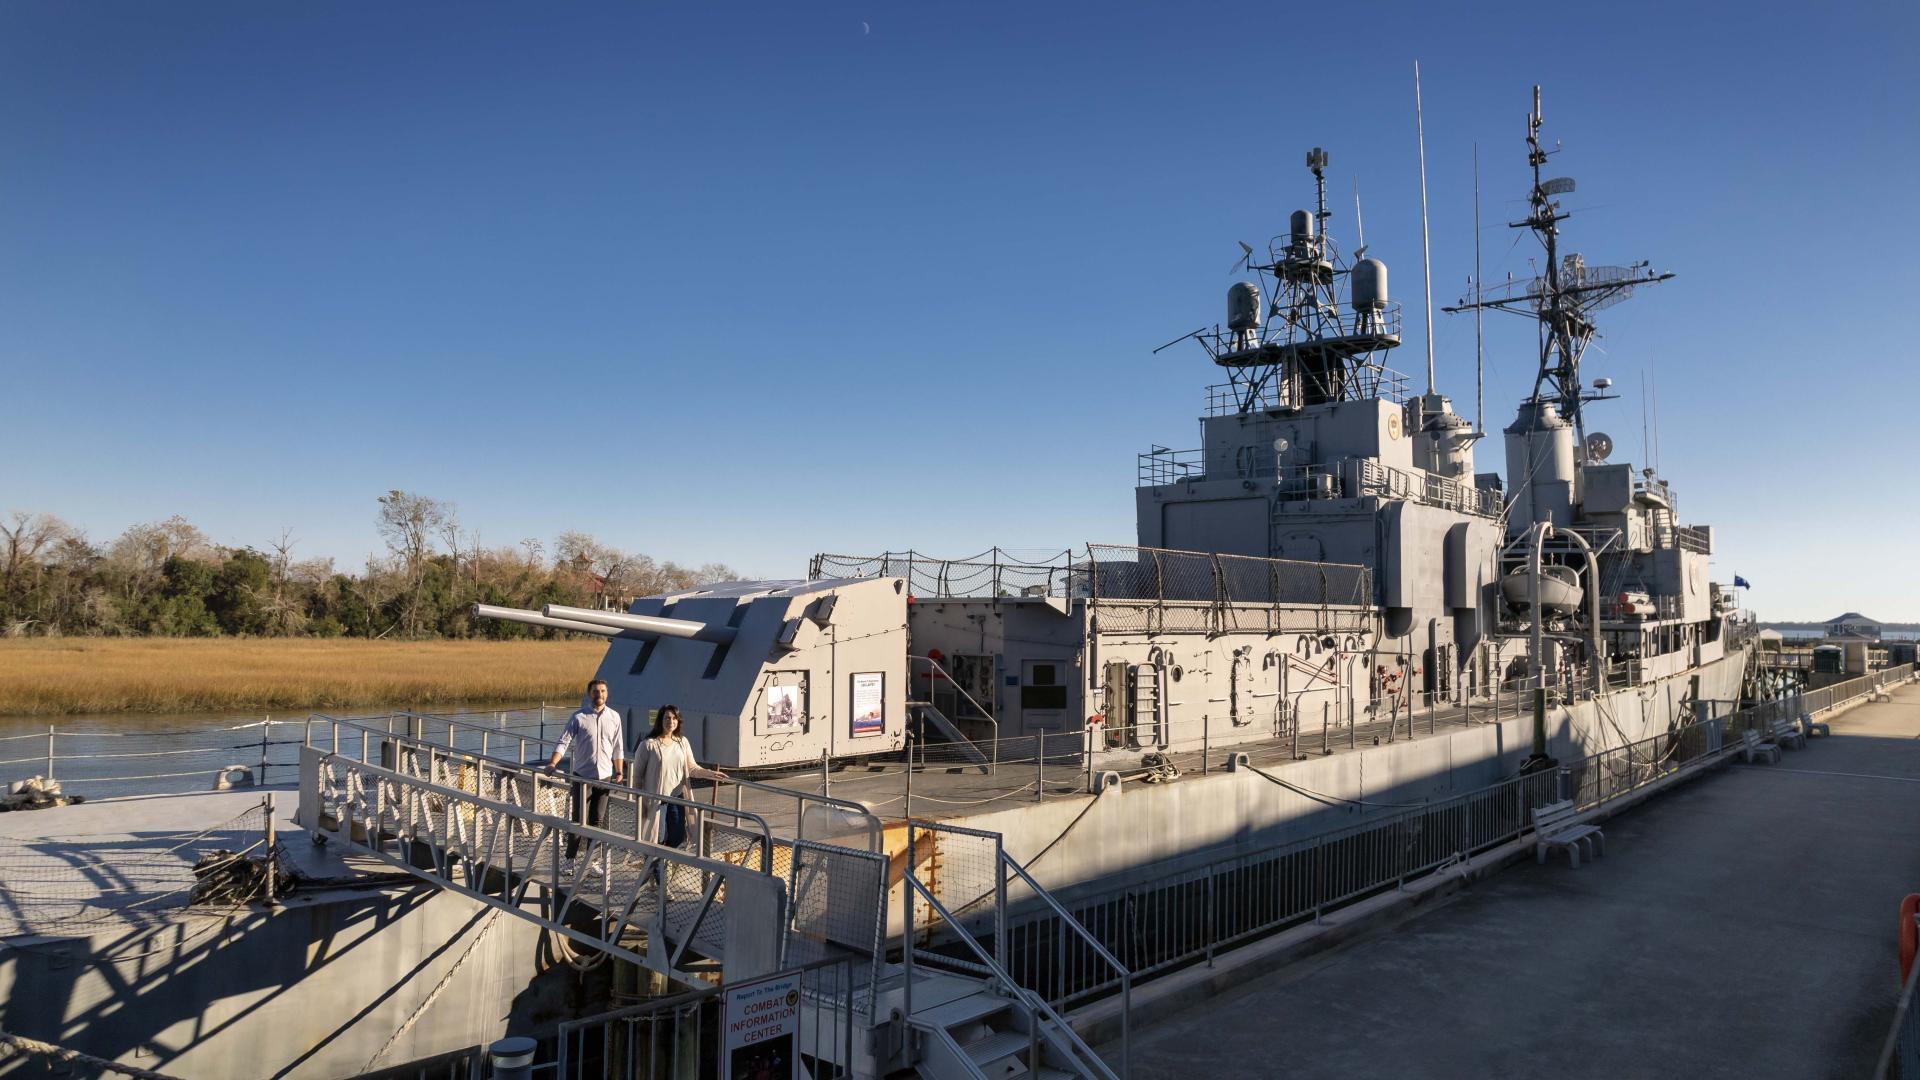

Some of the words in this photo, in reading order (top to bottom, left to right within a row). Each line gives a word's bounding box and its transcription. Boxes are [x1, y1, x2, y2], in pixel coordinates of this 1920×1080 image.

[737, 991, 755, 1000] Report
[744, 996, 785, 1015] COMBAT
[730, 1007, 796, 1032] INFORMATION
[744, 1023, 783, 1042] CENTER
